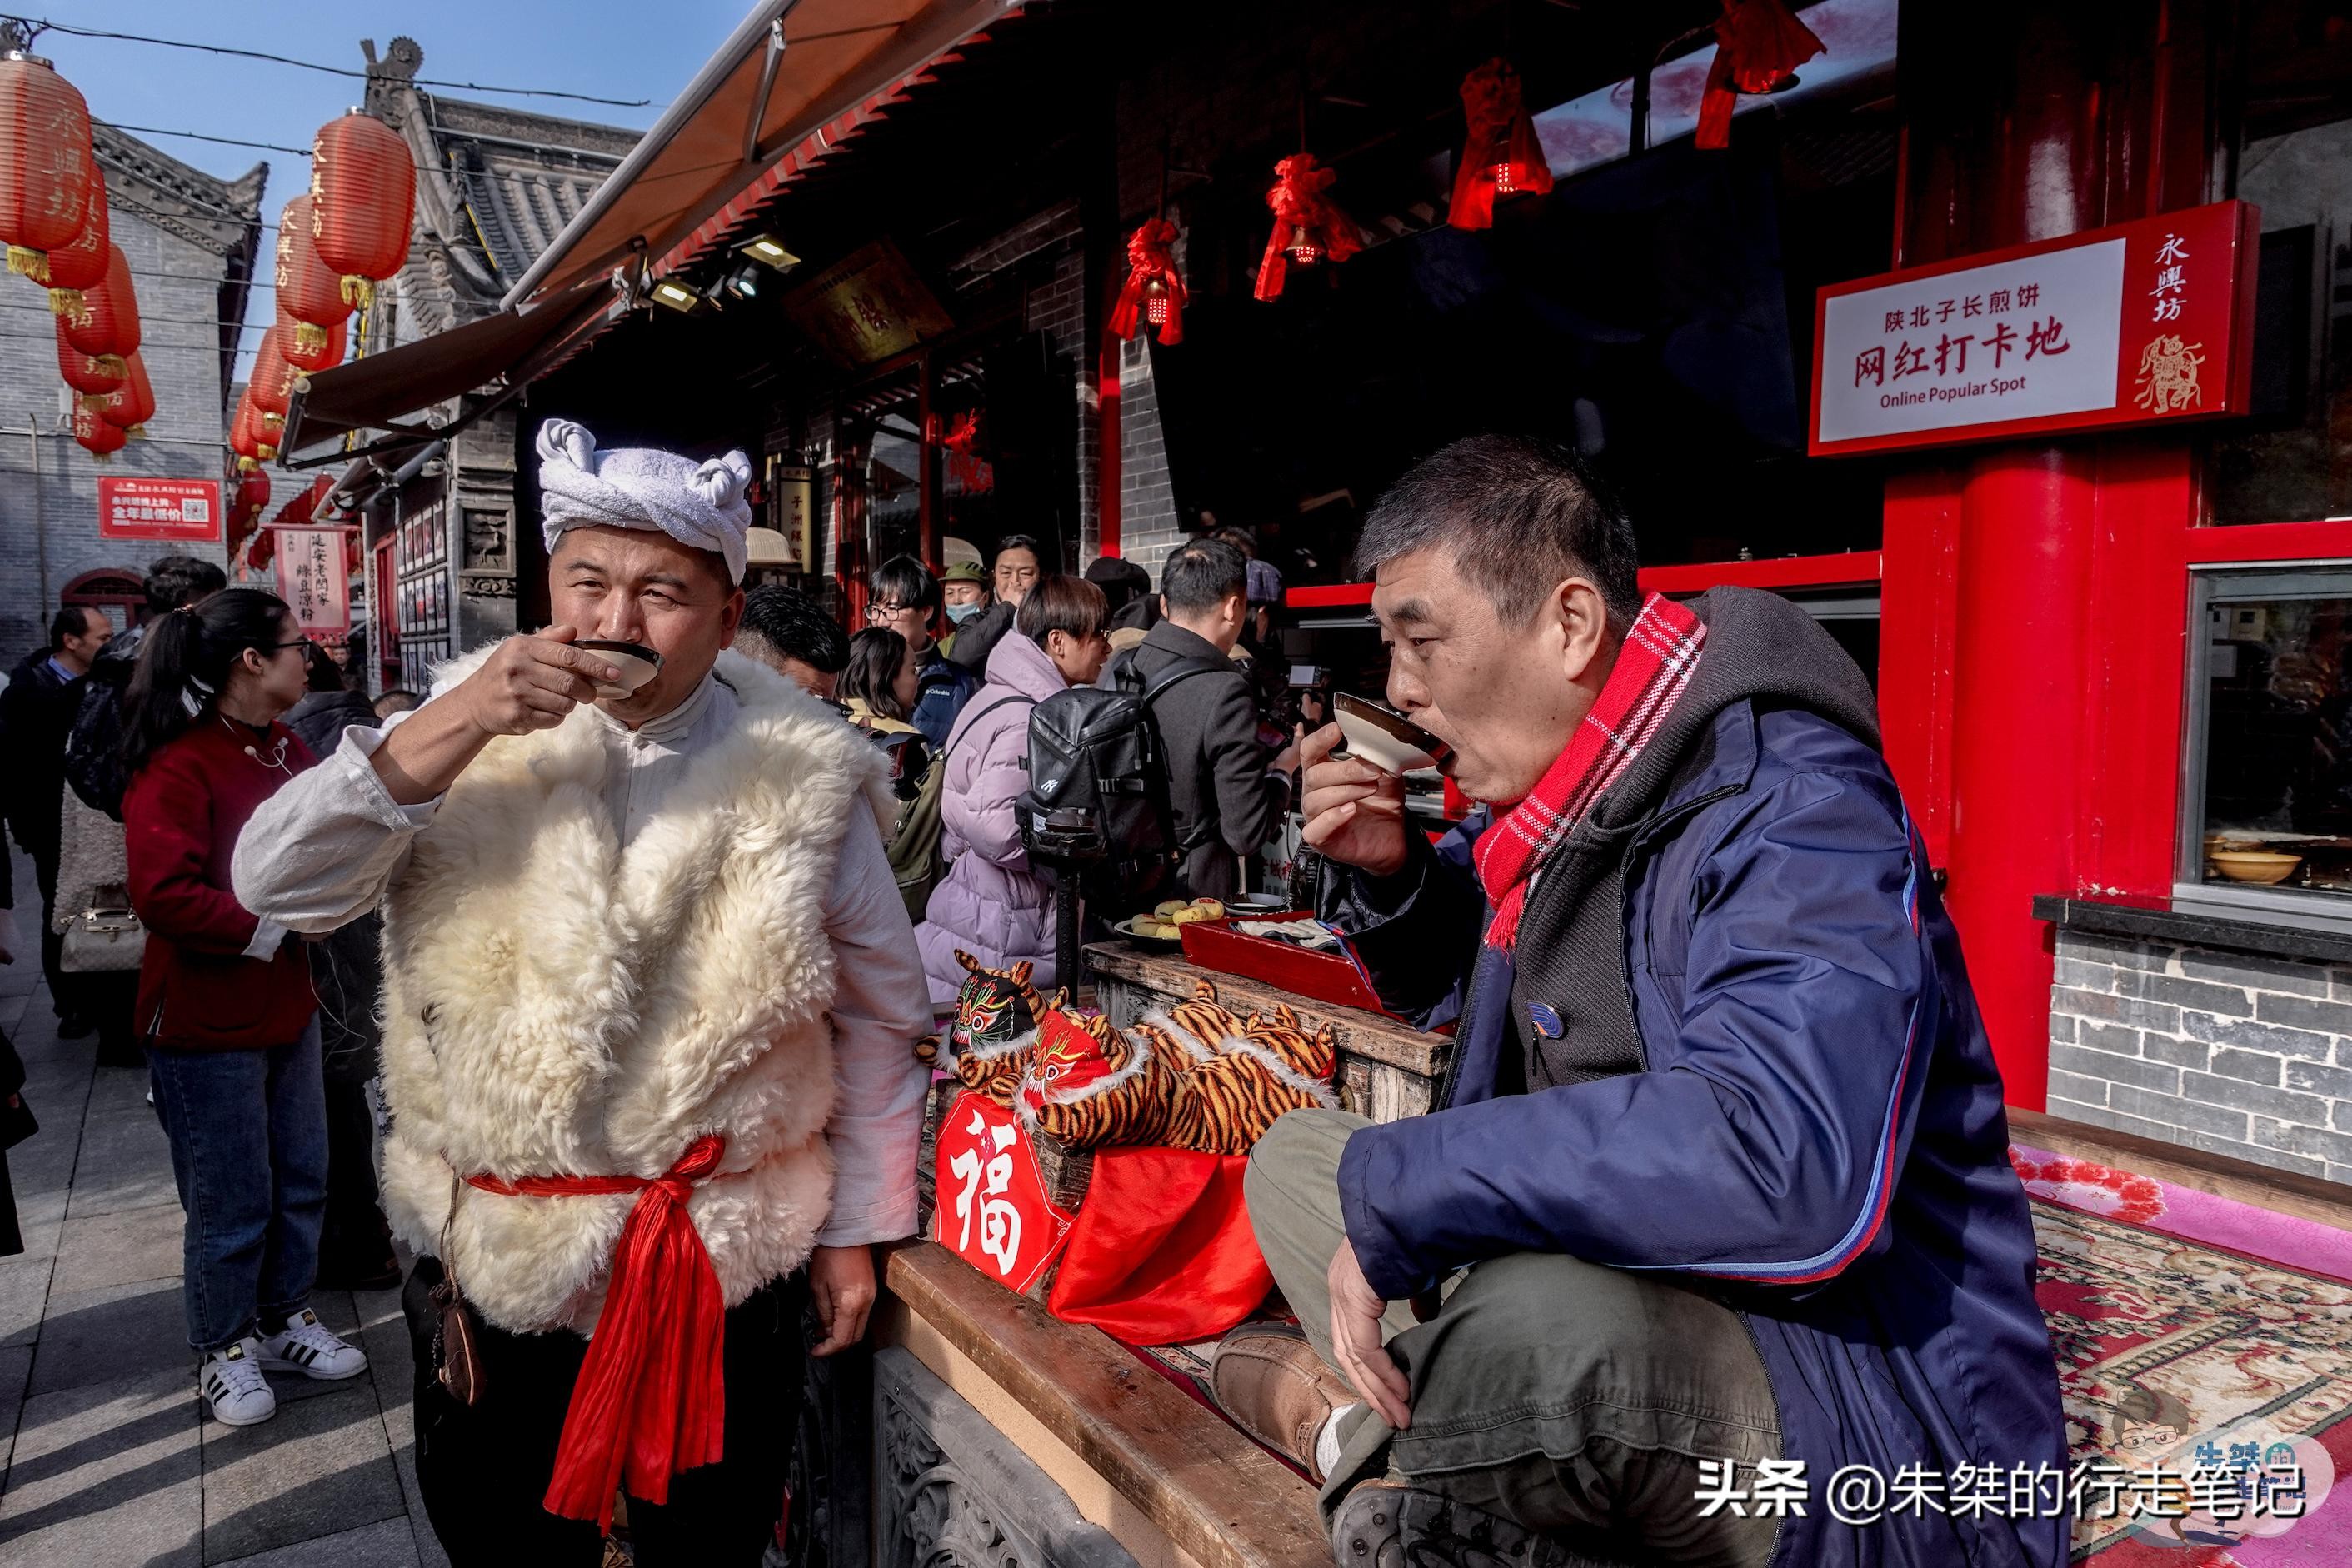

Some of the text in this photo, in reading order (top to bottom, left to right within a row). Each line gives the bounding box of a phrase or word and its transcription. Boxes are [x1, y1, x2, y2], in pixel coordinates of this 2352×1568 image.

[1885, 283, 2040, 333] 陕北子长煎饼
[2148, 233, 2190, 322] 永興坊
[1854, 315, 2070, 388] 网红打卡地
[1880, 376, 2026, 408] Online Popular Spot
[112, 506, 182, 522] 全年最低价
[950, 1109, 1021, 1276] 福
